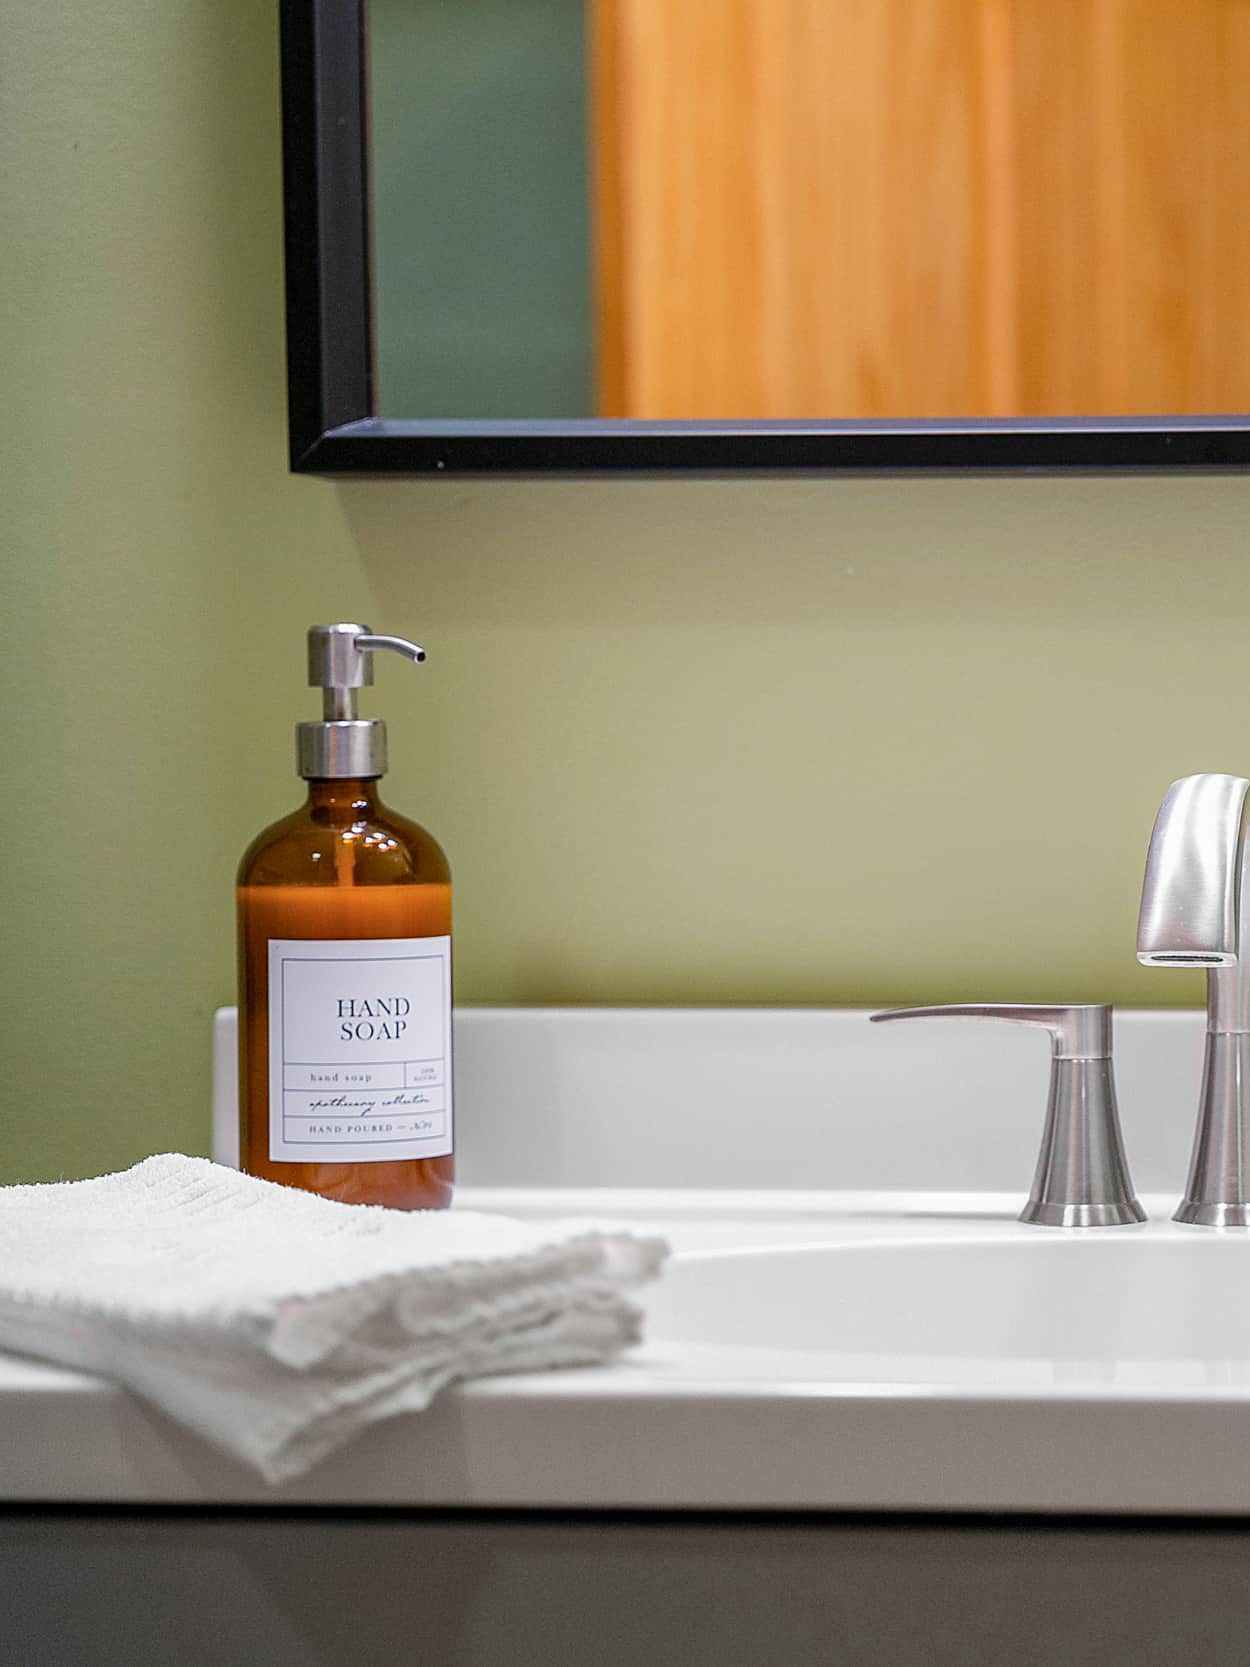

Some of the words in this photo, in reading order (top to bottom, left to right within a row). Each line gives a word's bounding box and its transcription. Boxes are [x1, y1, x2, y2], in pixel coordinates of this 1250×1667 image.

[337, 998, 410, 1018] HAND
[340, 1021, 407, 1041] SOAP
[310, 1073, 338, 1082] hand
[345, 1073, 372, 1083] soap
[309, 1125, 342, 1134] HAND
[347, 1124, 393, 1133] POURED
